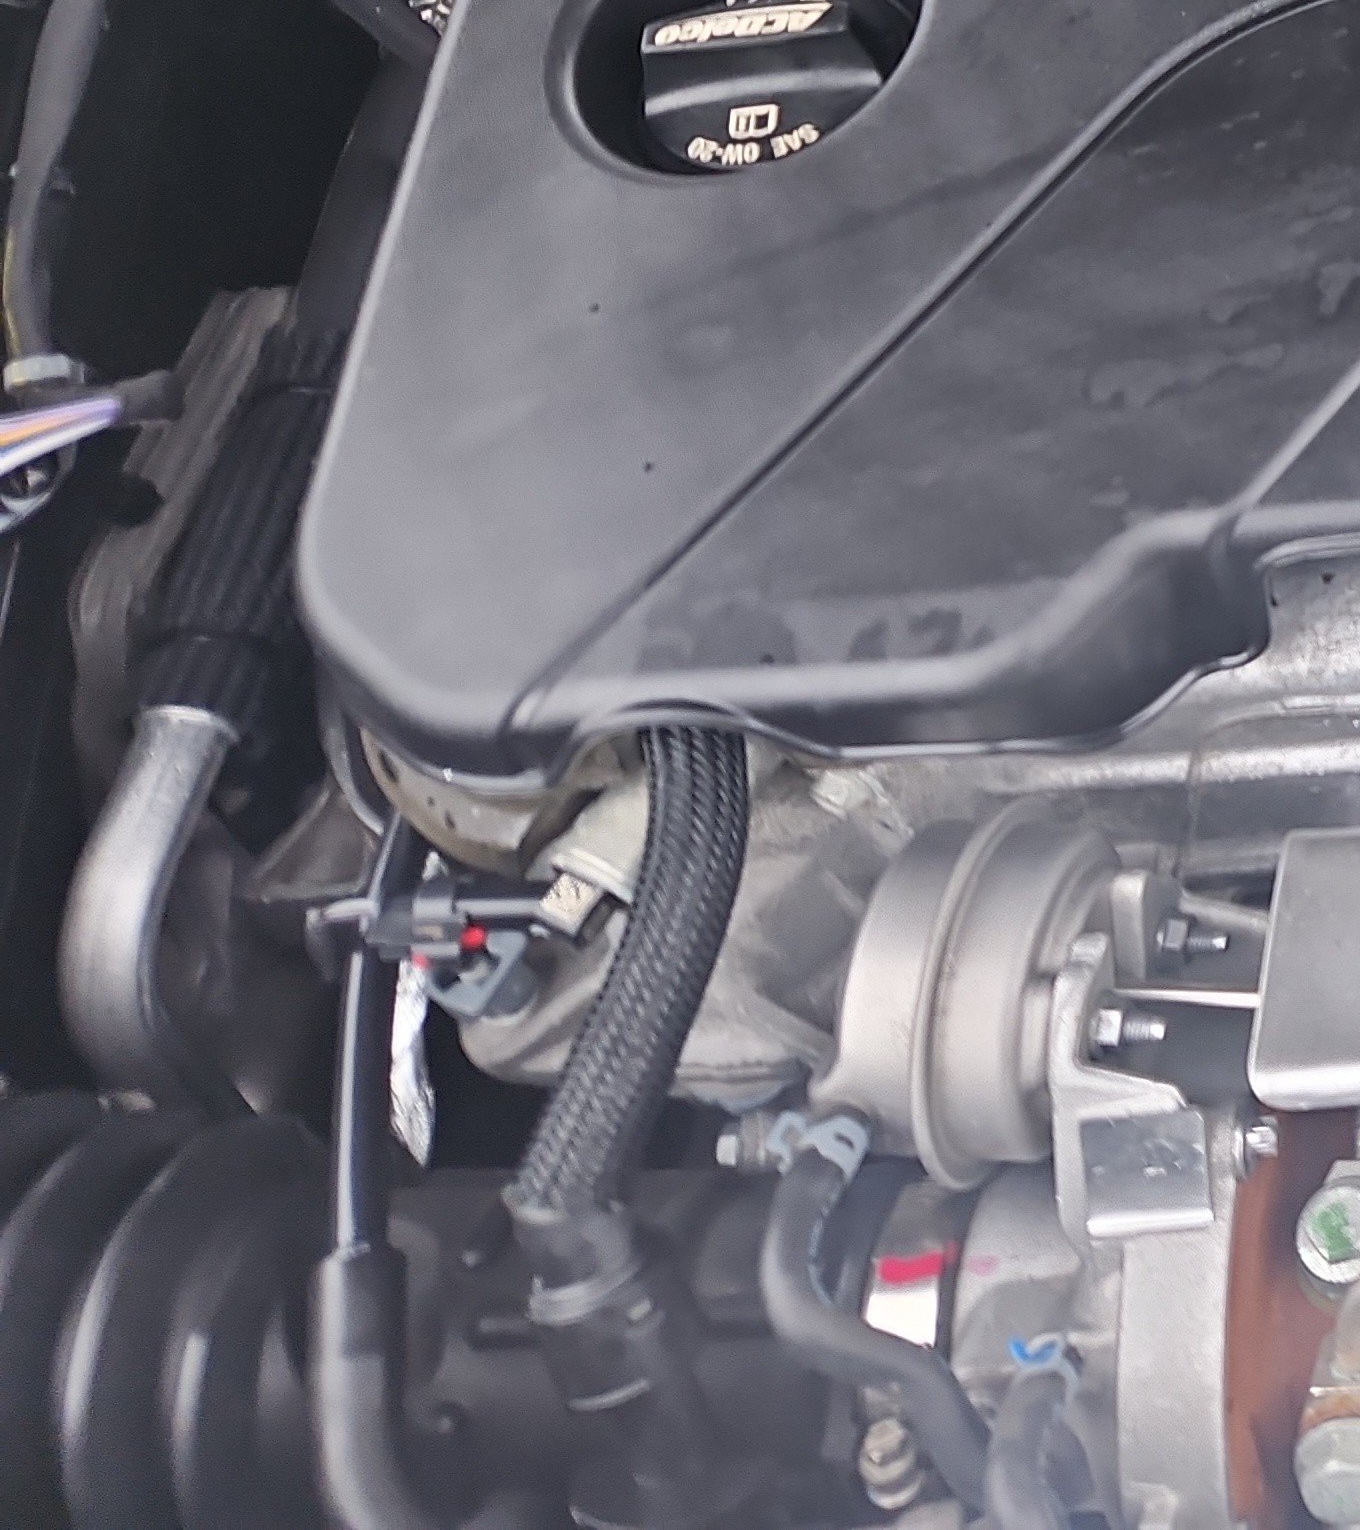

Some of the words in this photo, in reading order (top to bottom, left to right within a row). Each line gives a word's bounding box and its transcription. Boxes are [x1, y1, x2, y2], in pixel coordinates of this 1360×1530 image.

[654, 6, 832, 47] ACDelco
[686, 135, 761, 167] 0W-20
[771, 123, 820, 159] SAE
